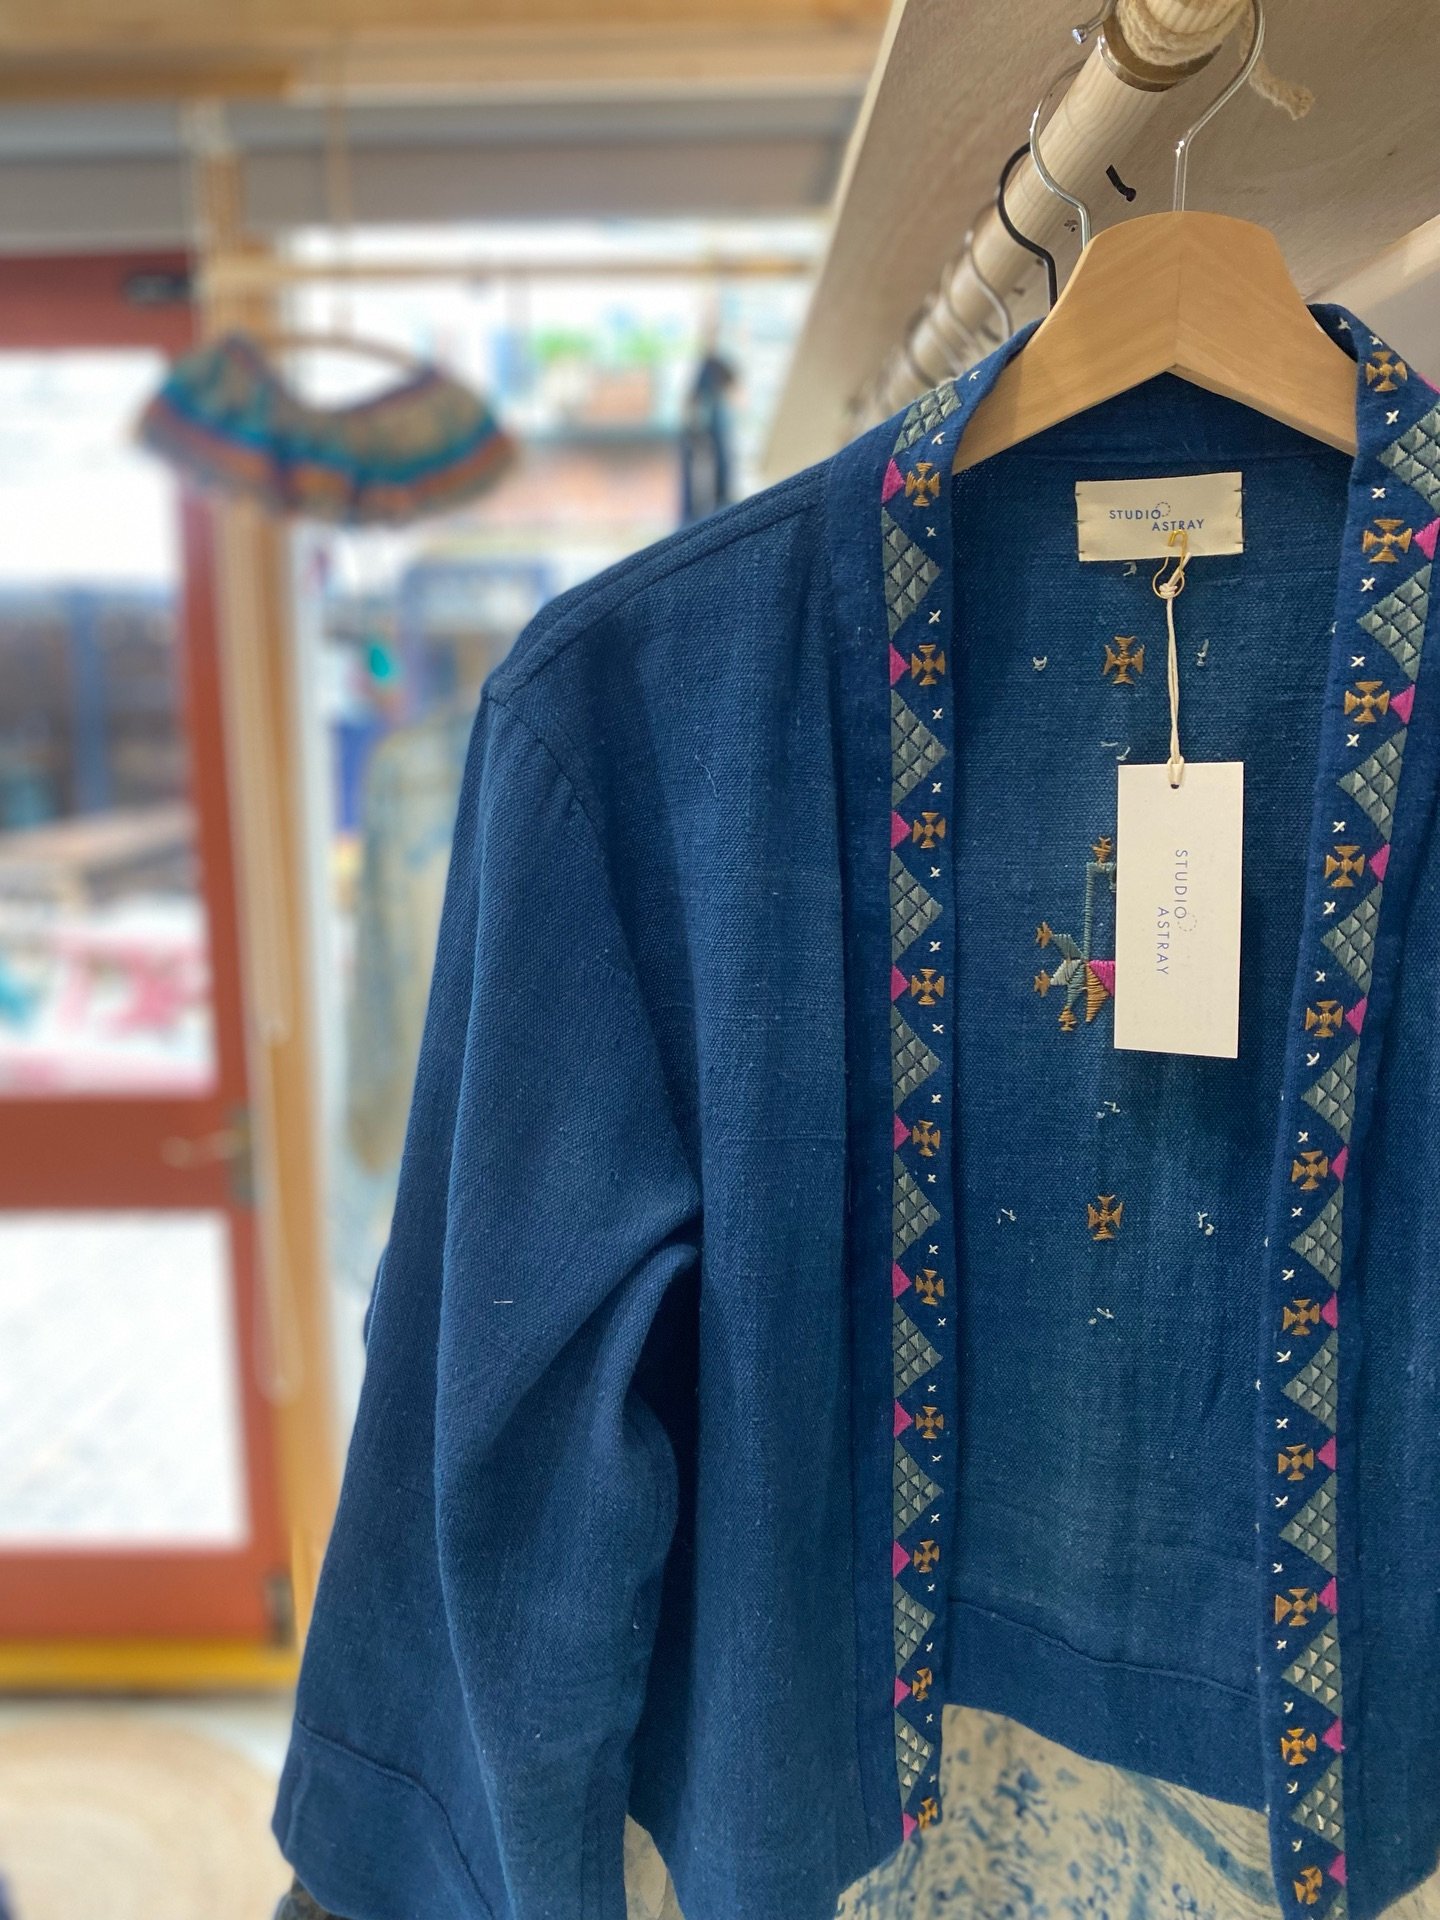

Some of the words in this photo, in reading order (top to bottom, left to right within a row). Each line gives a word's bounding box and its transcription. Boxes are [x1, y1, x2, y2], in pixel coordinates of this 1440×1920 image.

[1109, 509, 1161, 520] STUDIO
[1151, 519, 1205, 532] ASTRAY
[1174, 849, 1189, 919] STUDIO
[1156, 906, 1170, 975] ASTRAY
